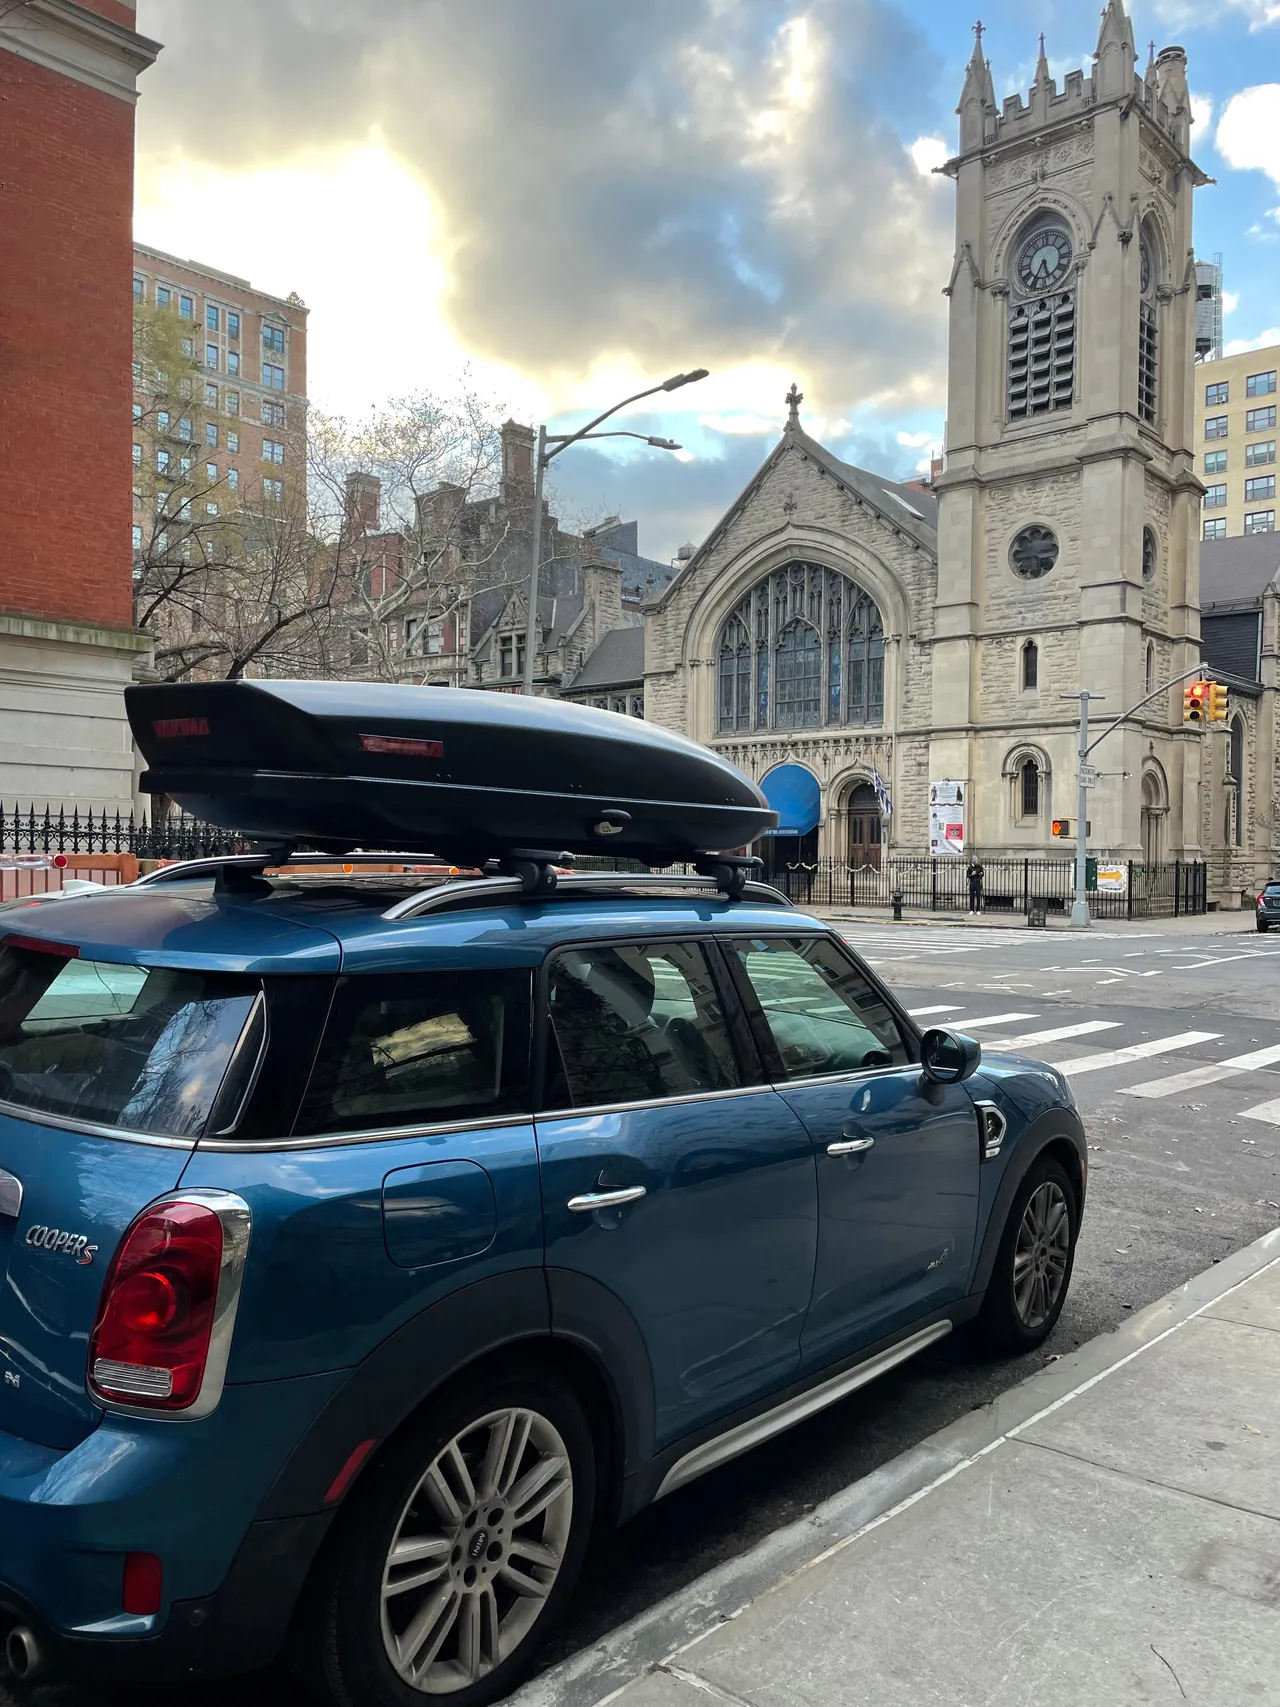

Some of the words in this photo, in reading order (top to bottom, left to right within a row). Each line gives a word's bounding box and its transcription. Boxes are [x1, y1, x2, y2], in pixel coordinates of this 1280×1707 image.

[25, 1224, 88, 1256] COOPER
[75, 1244, 99, 1265] S
[471, 1532, 486, 1557] MINI
